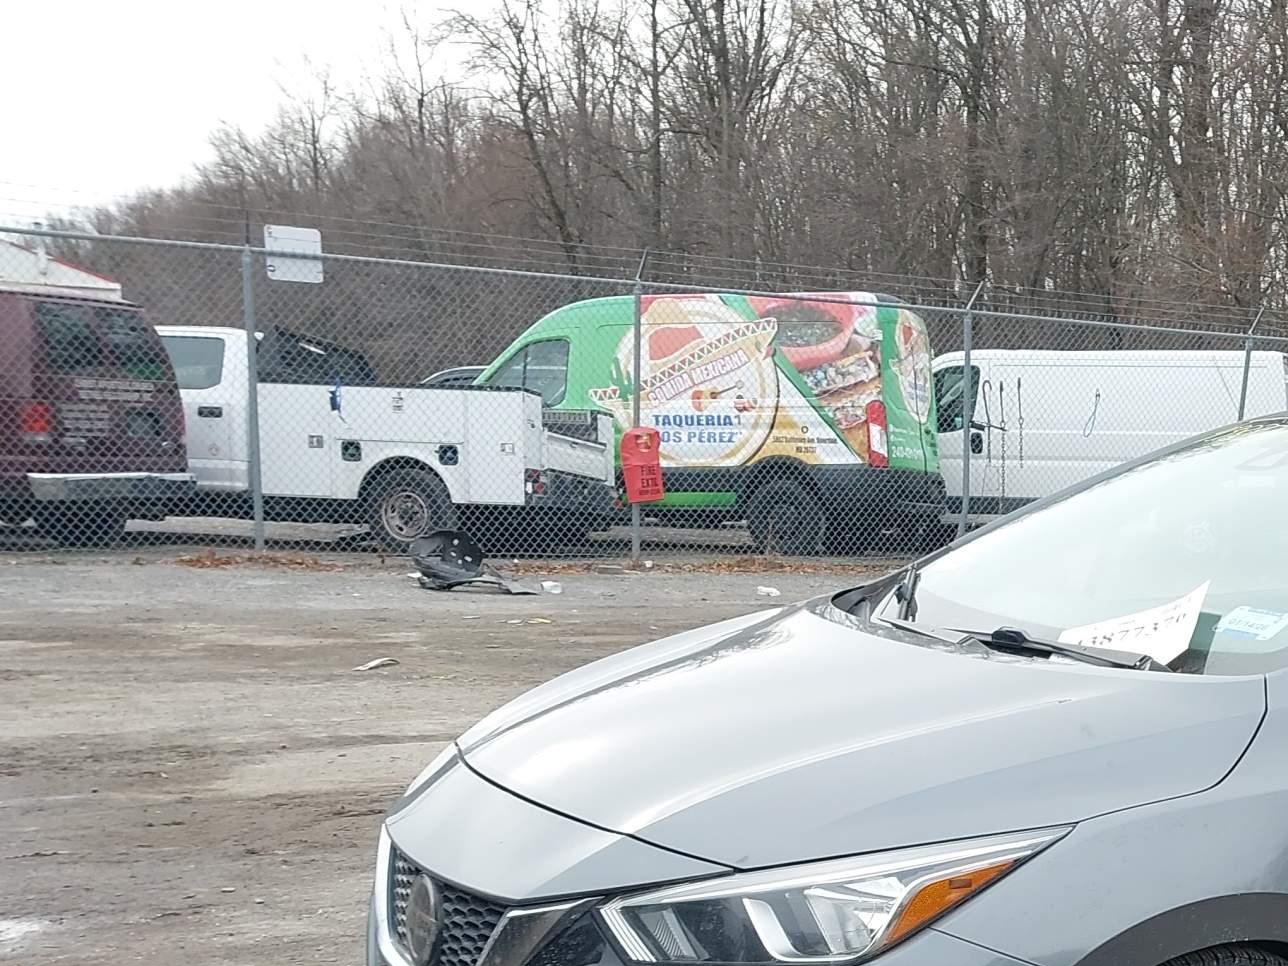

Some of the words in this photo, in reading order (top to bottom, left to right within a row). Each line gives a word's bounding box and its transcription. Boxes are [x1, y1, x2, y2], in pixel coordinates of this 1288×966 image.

[648, 372, 693, 407] COMIDA
[690, 348, 750, 384] MEXICANA
[660, 431, 682, 443] OS
